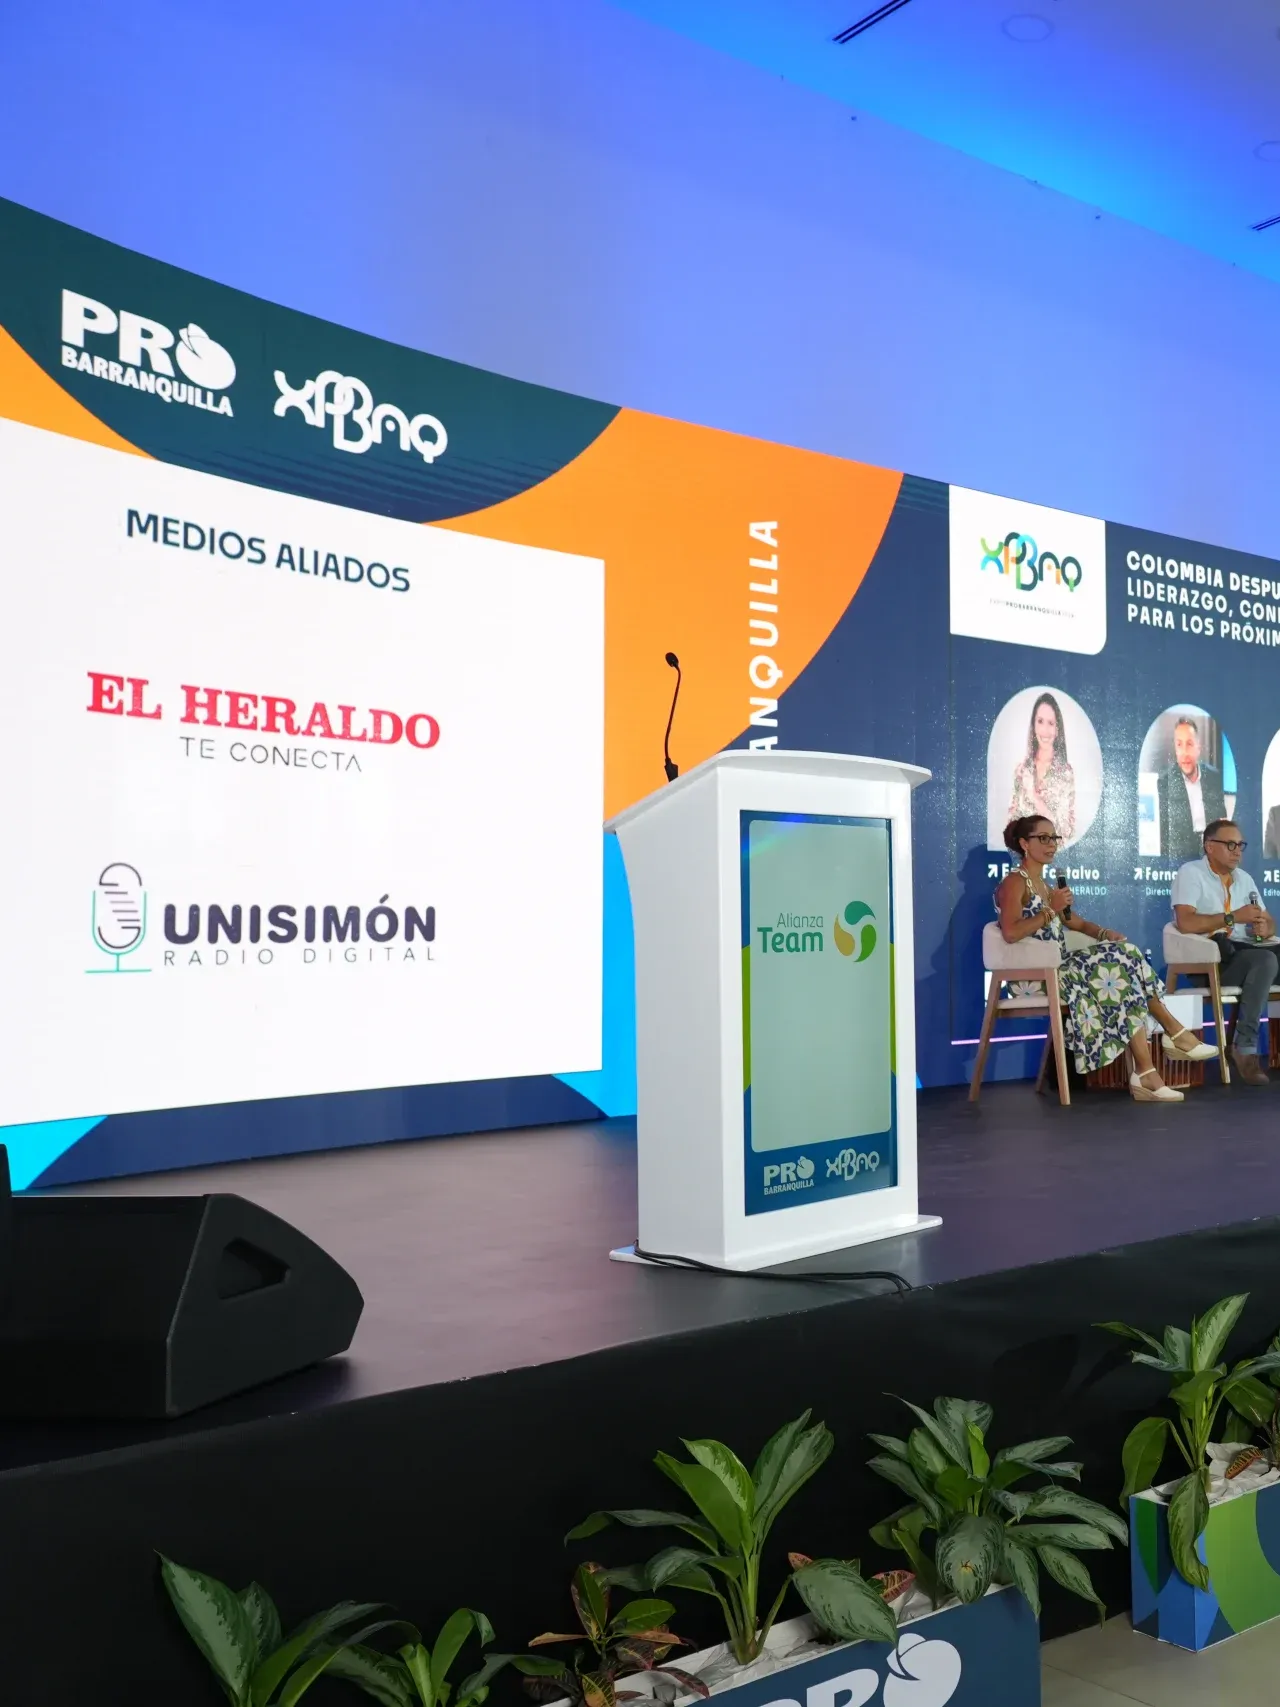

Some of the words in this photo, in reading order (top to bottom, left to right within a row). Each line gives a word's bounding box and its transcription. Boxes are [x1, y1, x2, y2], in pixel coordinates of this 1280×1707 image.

[61, 288, 237, 391] PRO
[61, 344, 235, 418] BARRANQUILLA
[126, 508, 267, 565] MEDIOS
[275, 542, 411, 593] ALIADOS
[1126, 550, 1224, 588] COLOMBIA
[1127, 577, 1234, 618] LIDERAZGO,
[748, 520, 784, 751] ANQUILLA
[1127, 603, 1175, 630] PARA
[1181, 613, 1215, 636] LOS
[85, 670, 164, 720] EL
[179, 683, 441, 750] HERALDO
[179, 736, 216, 760] TE
[229, 741, 363, 773] CONECTA
[1042, 867, 1100, 881] Fotalvo
[163, 894, 437, 945] UNISIMÓN
[776, 912, 824, 928] Alianza
[163, 948, 275, 967] RADIO
[303, 946, 436, 965] DIGITAL
[757, 926, 823, 953] Team
[763, 1155, 815, 1187] PRO
[763, 1178, 815, 1196] BARRANQUILLA
